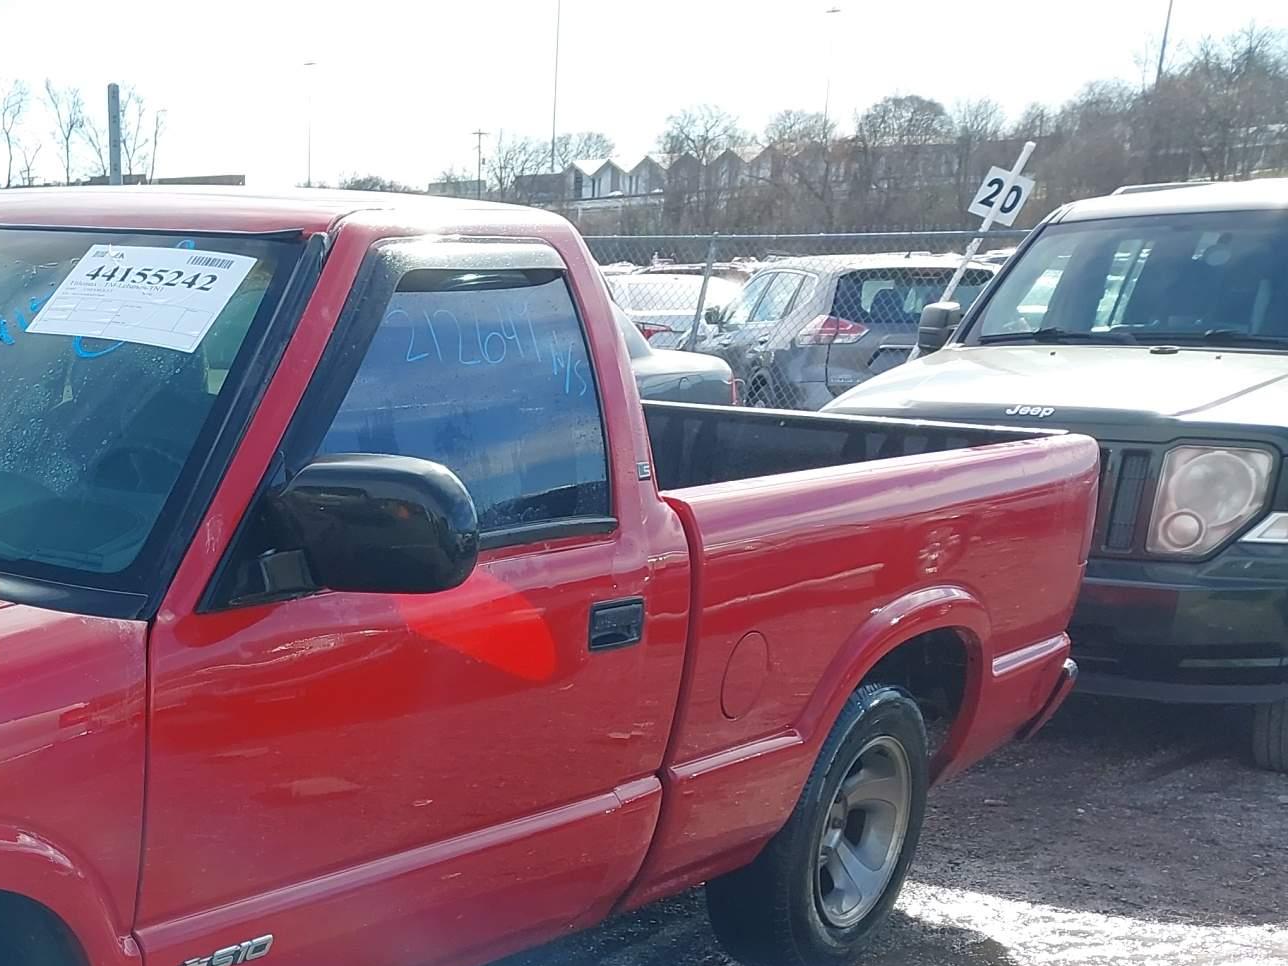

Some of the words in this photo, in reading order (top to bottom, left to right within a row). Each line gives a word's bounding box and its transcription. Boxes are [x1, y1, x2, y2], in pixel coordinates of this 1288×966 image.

[978, 177, 1022, 213] 20
[86, 264, 218, 292] 44155242
[1006, 404, 1055, 418] Jeep
